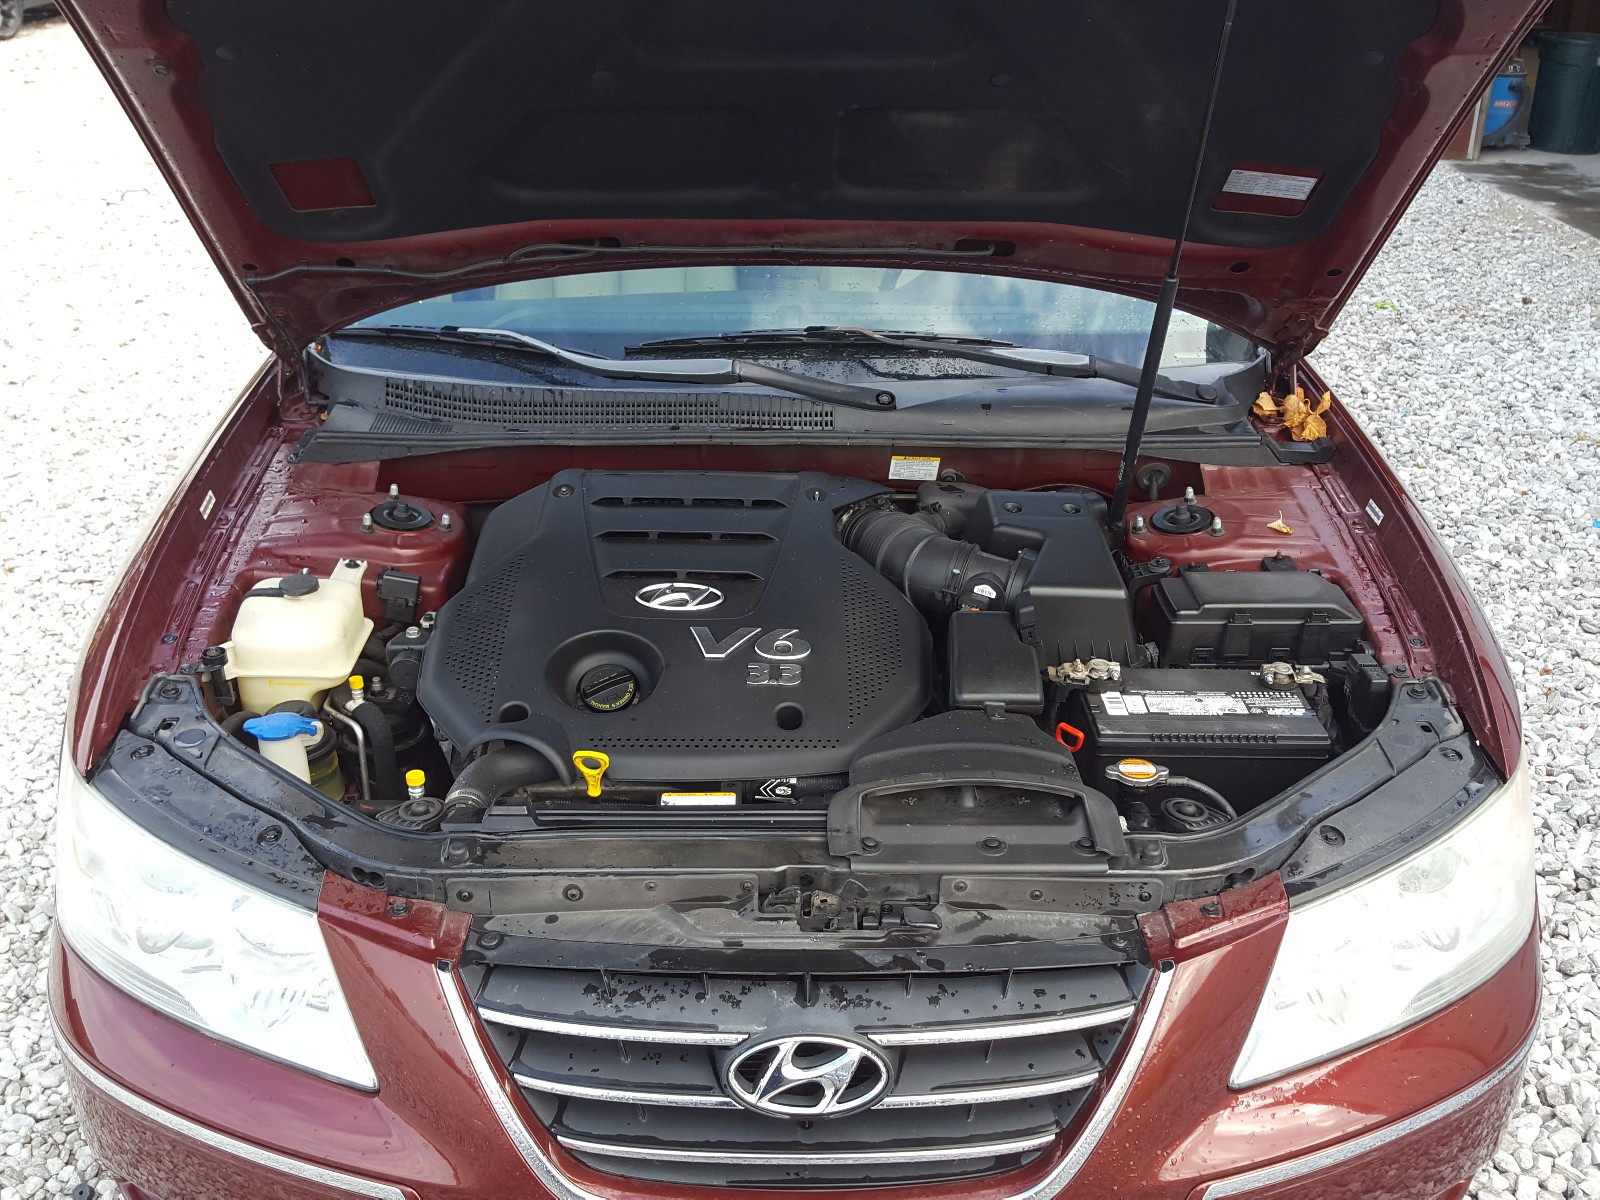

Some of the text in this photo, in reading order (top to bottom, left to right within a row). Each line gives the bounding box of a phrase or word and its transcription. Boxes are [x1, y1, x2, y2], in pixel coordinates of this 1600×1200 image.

[690, 626, 811, 660] V6
[746, 663, 802, 686] 3.3
[591, 699, 610, 709] MANUAL
